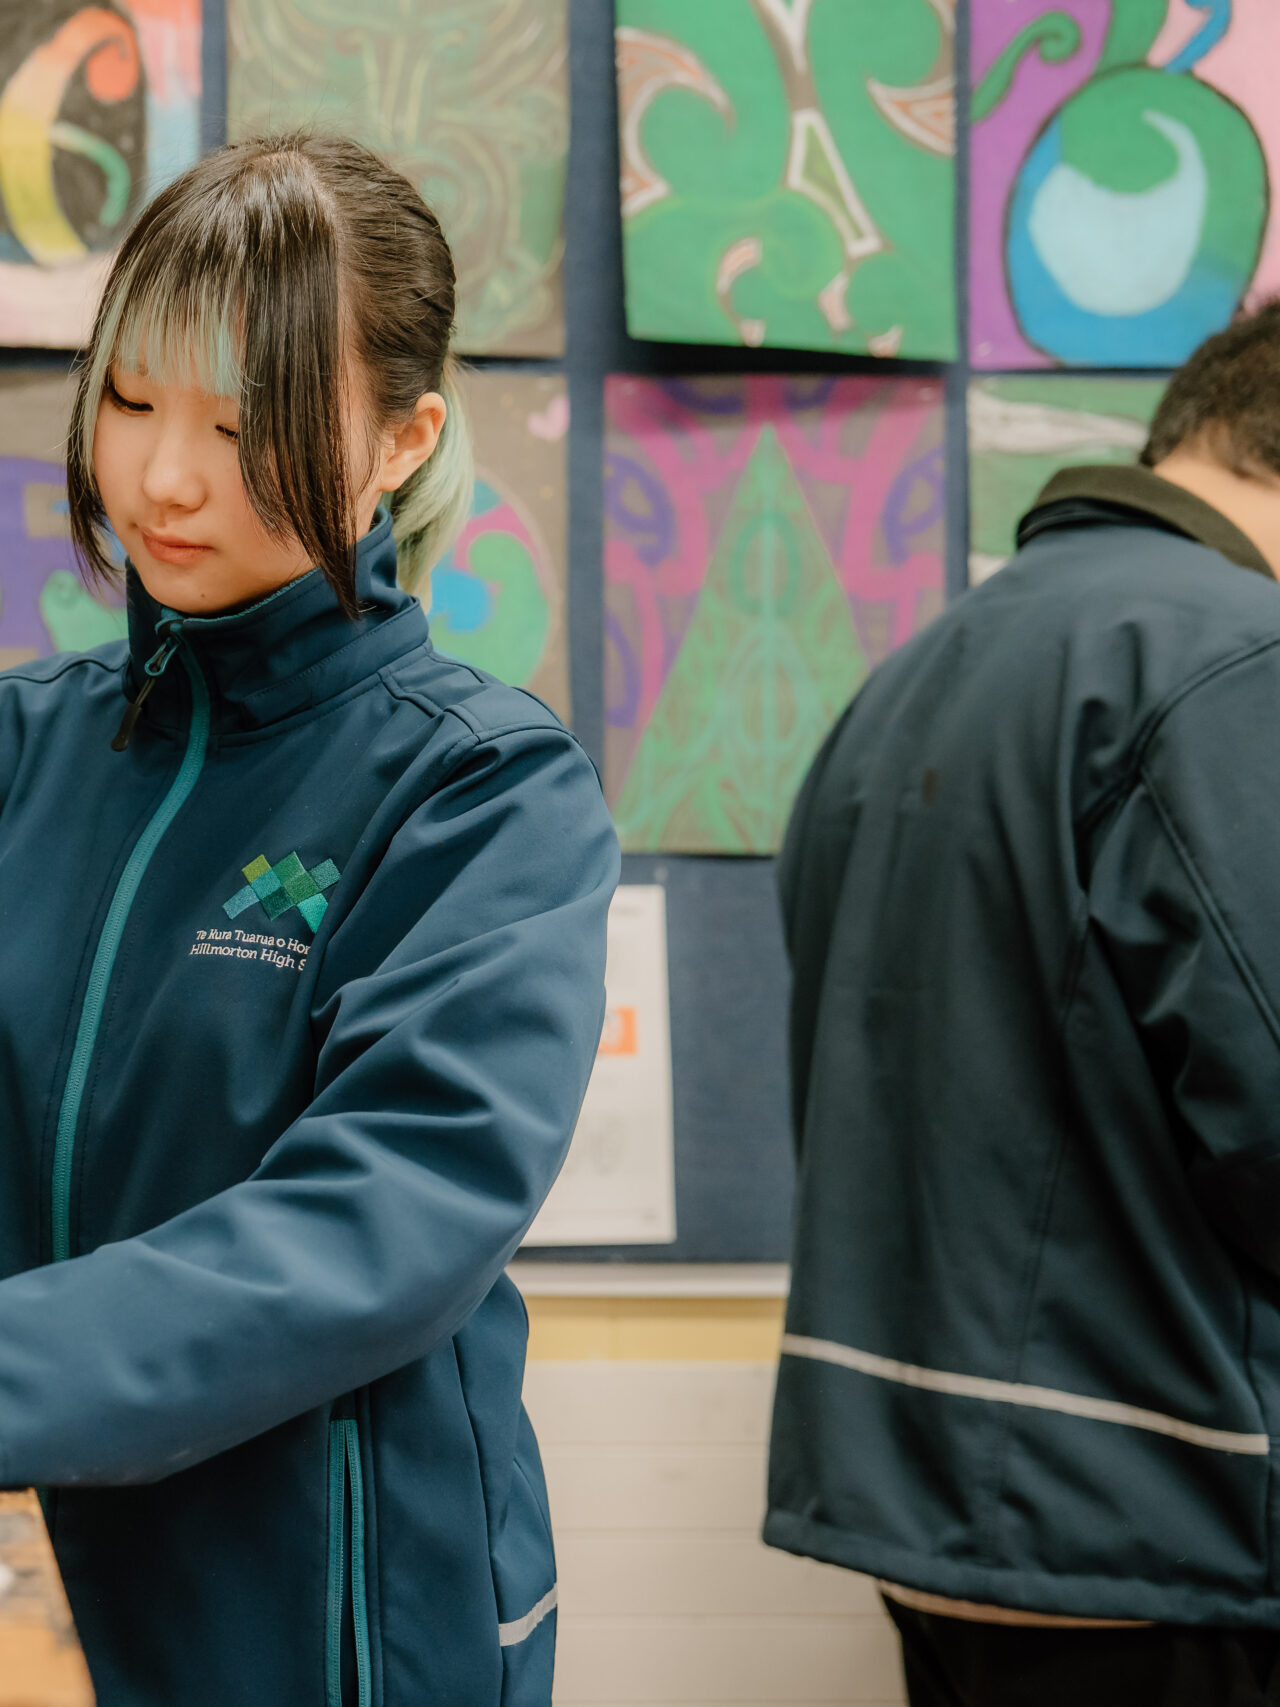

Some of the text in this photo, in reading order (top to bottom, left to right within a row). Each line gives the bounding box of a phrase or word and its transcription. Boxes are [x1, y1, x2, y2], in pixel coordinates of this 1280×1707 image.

[196, 930, 207, 940] Te
[234, 929, 275, 946] Tuarua
[276, 938, 286, 948] o
[189, 942, 257, 959] Hillmorton
[260, 948, 295, 968] High
